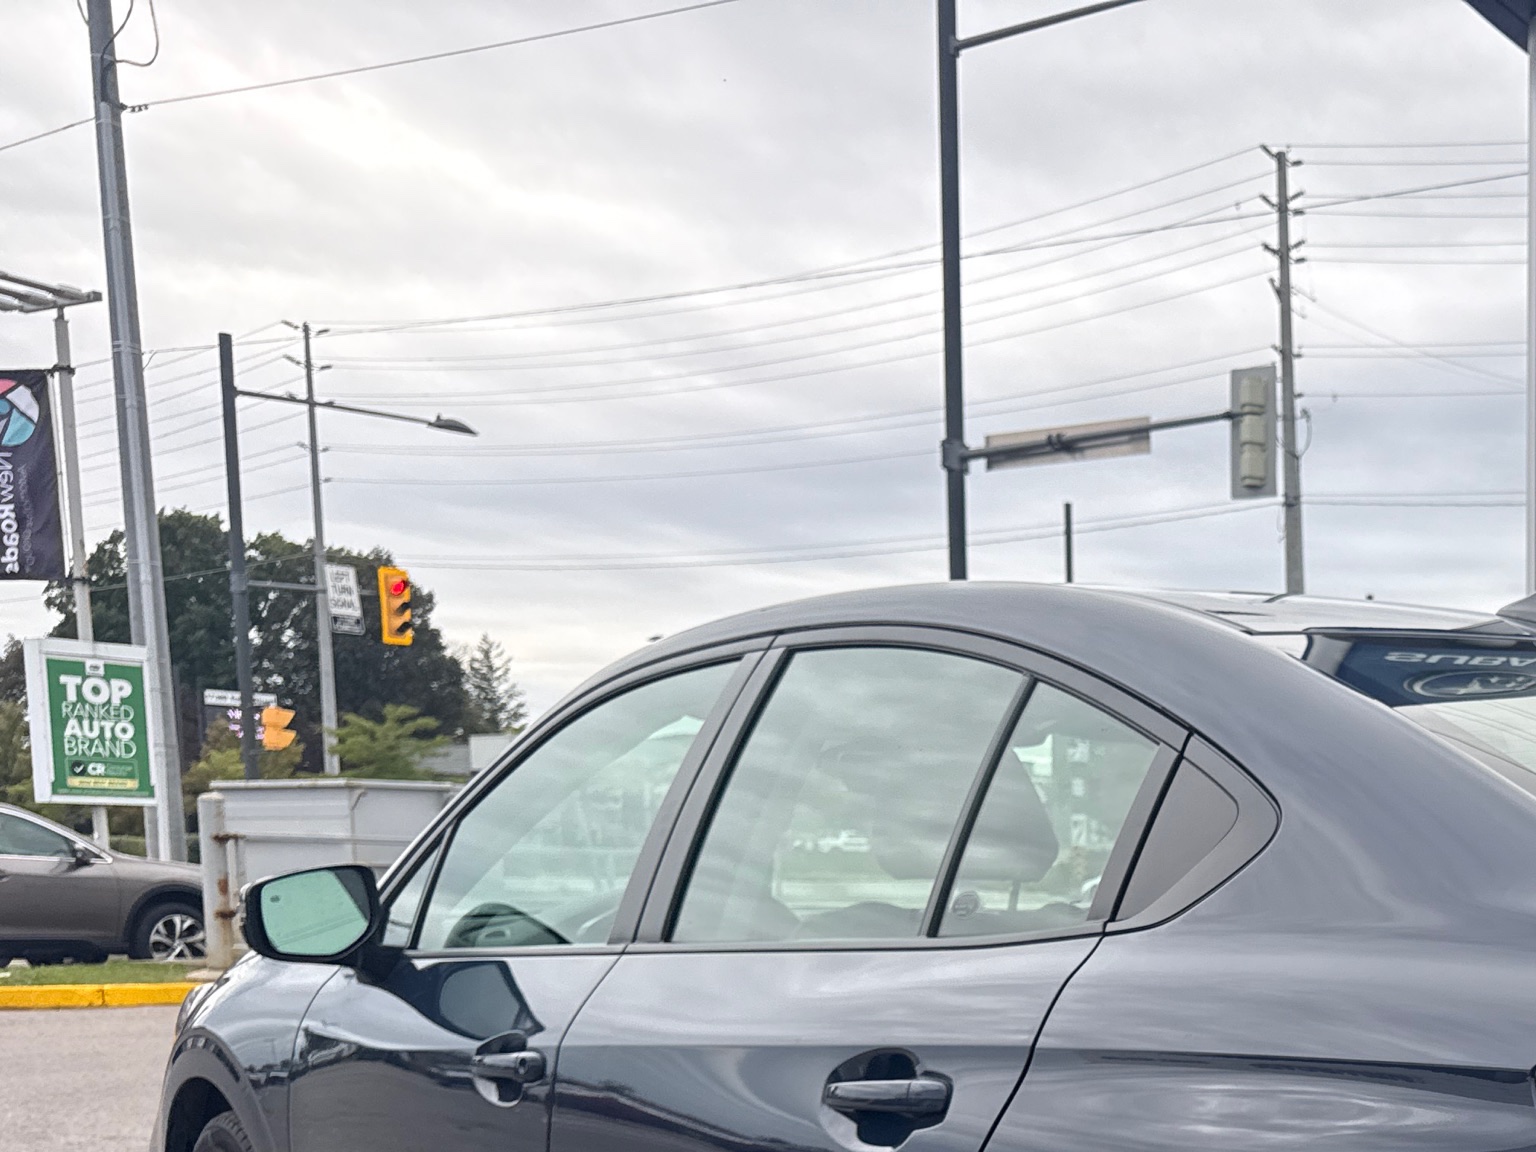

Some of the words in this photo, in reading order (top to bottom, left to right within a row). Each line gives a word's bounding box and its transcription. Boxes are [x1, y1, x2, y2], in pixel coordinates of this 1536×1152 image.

[59, 674, 133, 706] TOP
[62, 701, 135, 722] RANKED
[64, 718, 135, 741] AUTO
[64, 736, 137, 759] BRAND
